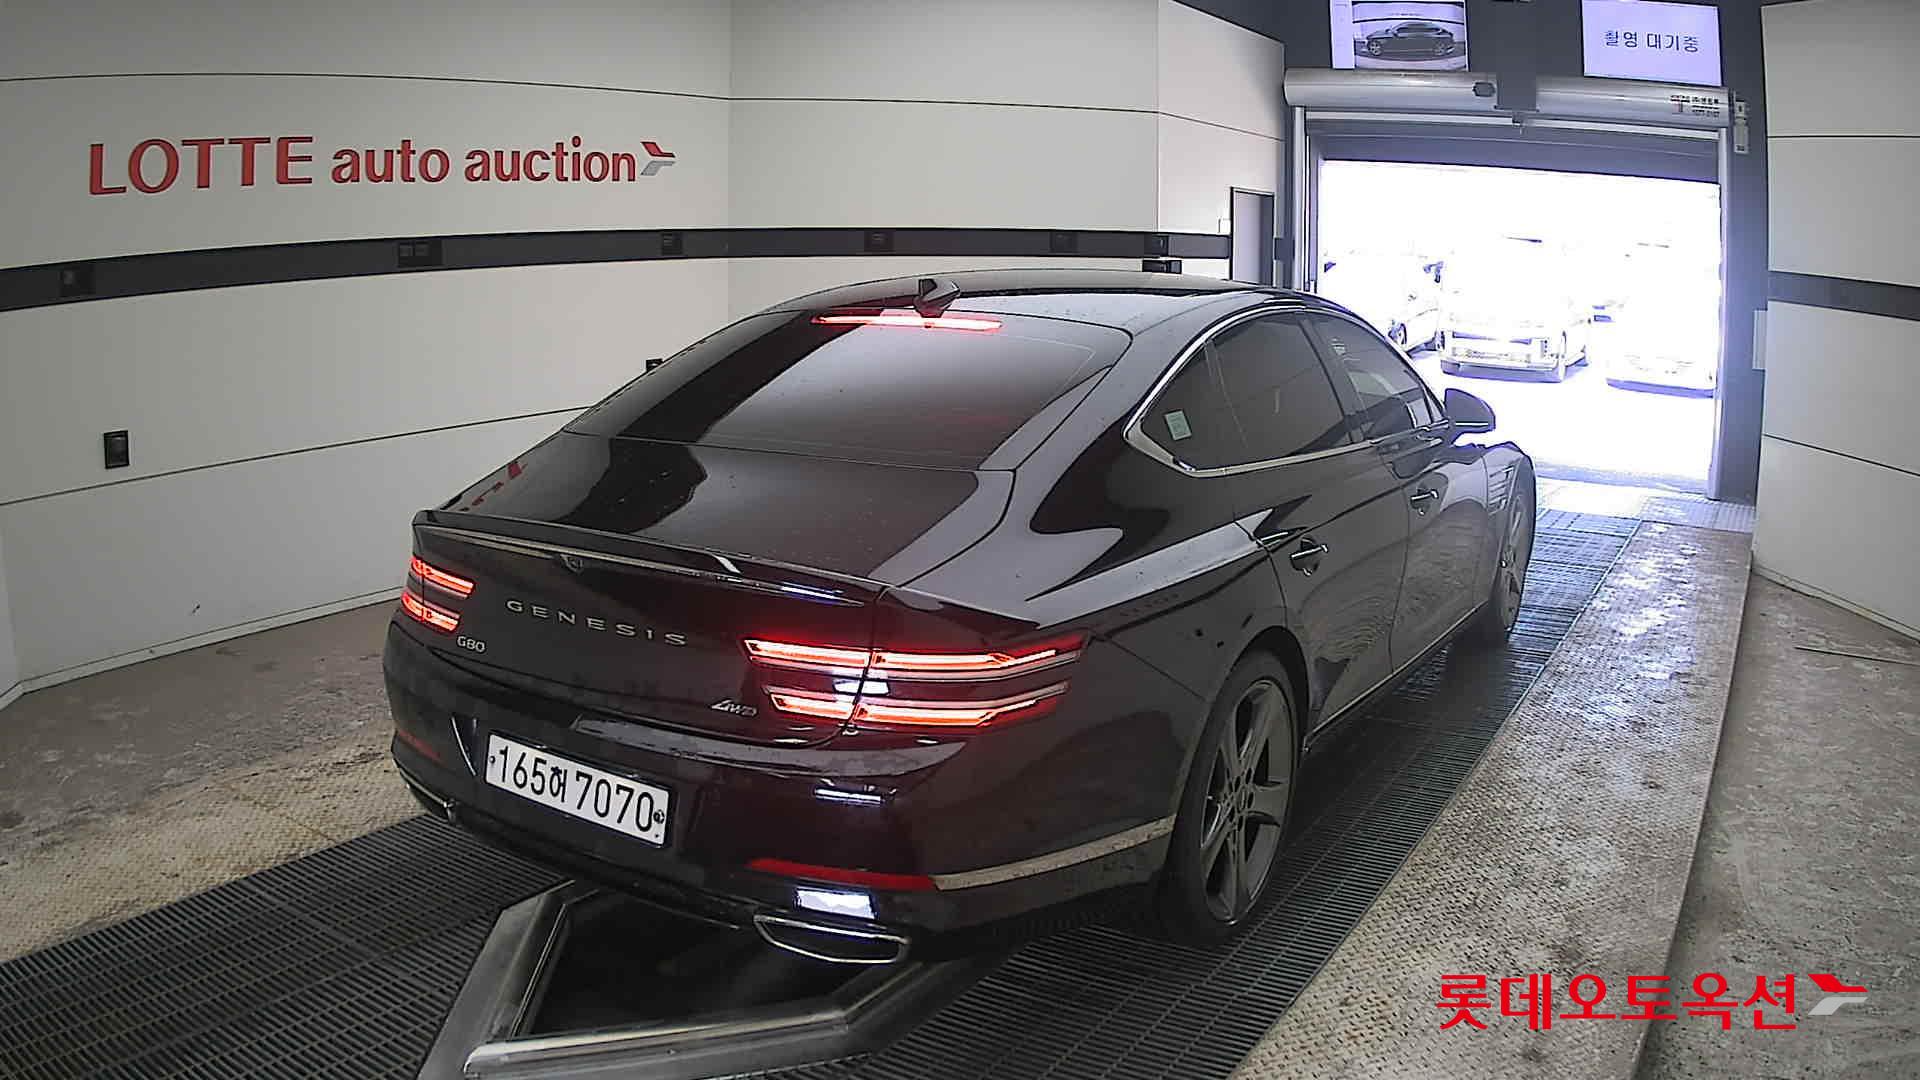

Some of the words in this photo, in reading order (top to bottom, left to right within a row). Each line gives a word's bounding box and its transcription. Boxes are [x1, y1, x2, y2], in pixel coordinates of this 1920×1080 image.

[1646, 33, 1699, 53] 대기중
[88, 136, 313, 195] LOTTE
[331, 139, 450, 183] auto
[463, 135, 637, 182] auction
[507, 599, 687, 646] GENESIS
[457, 635, 486, 653] G80
